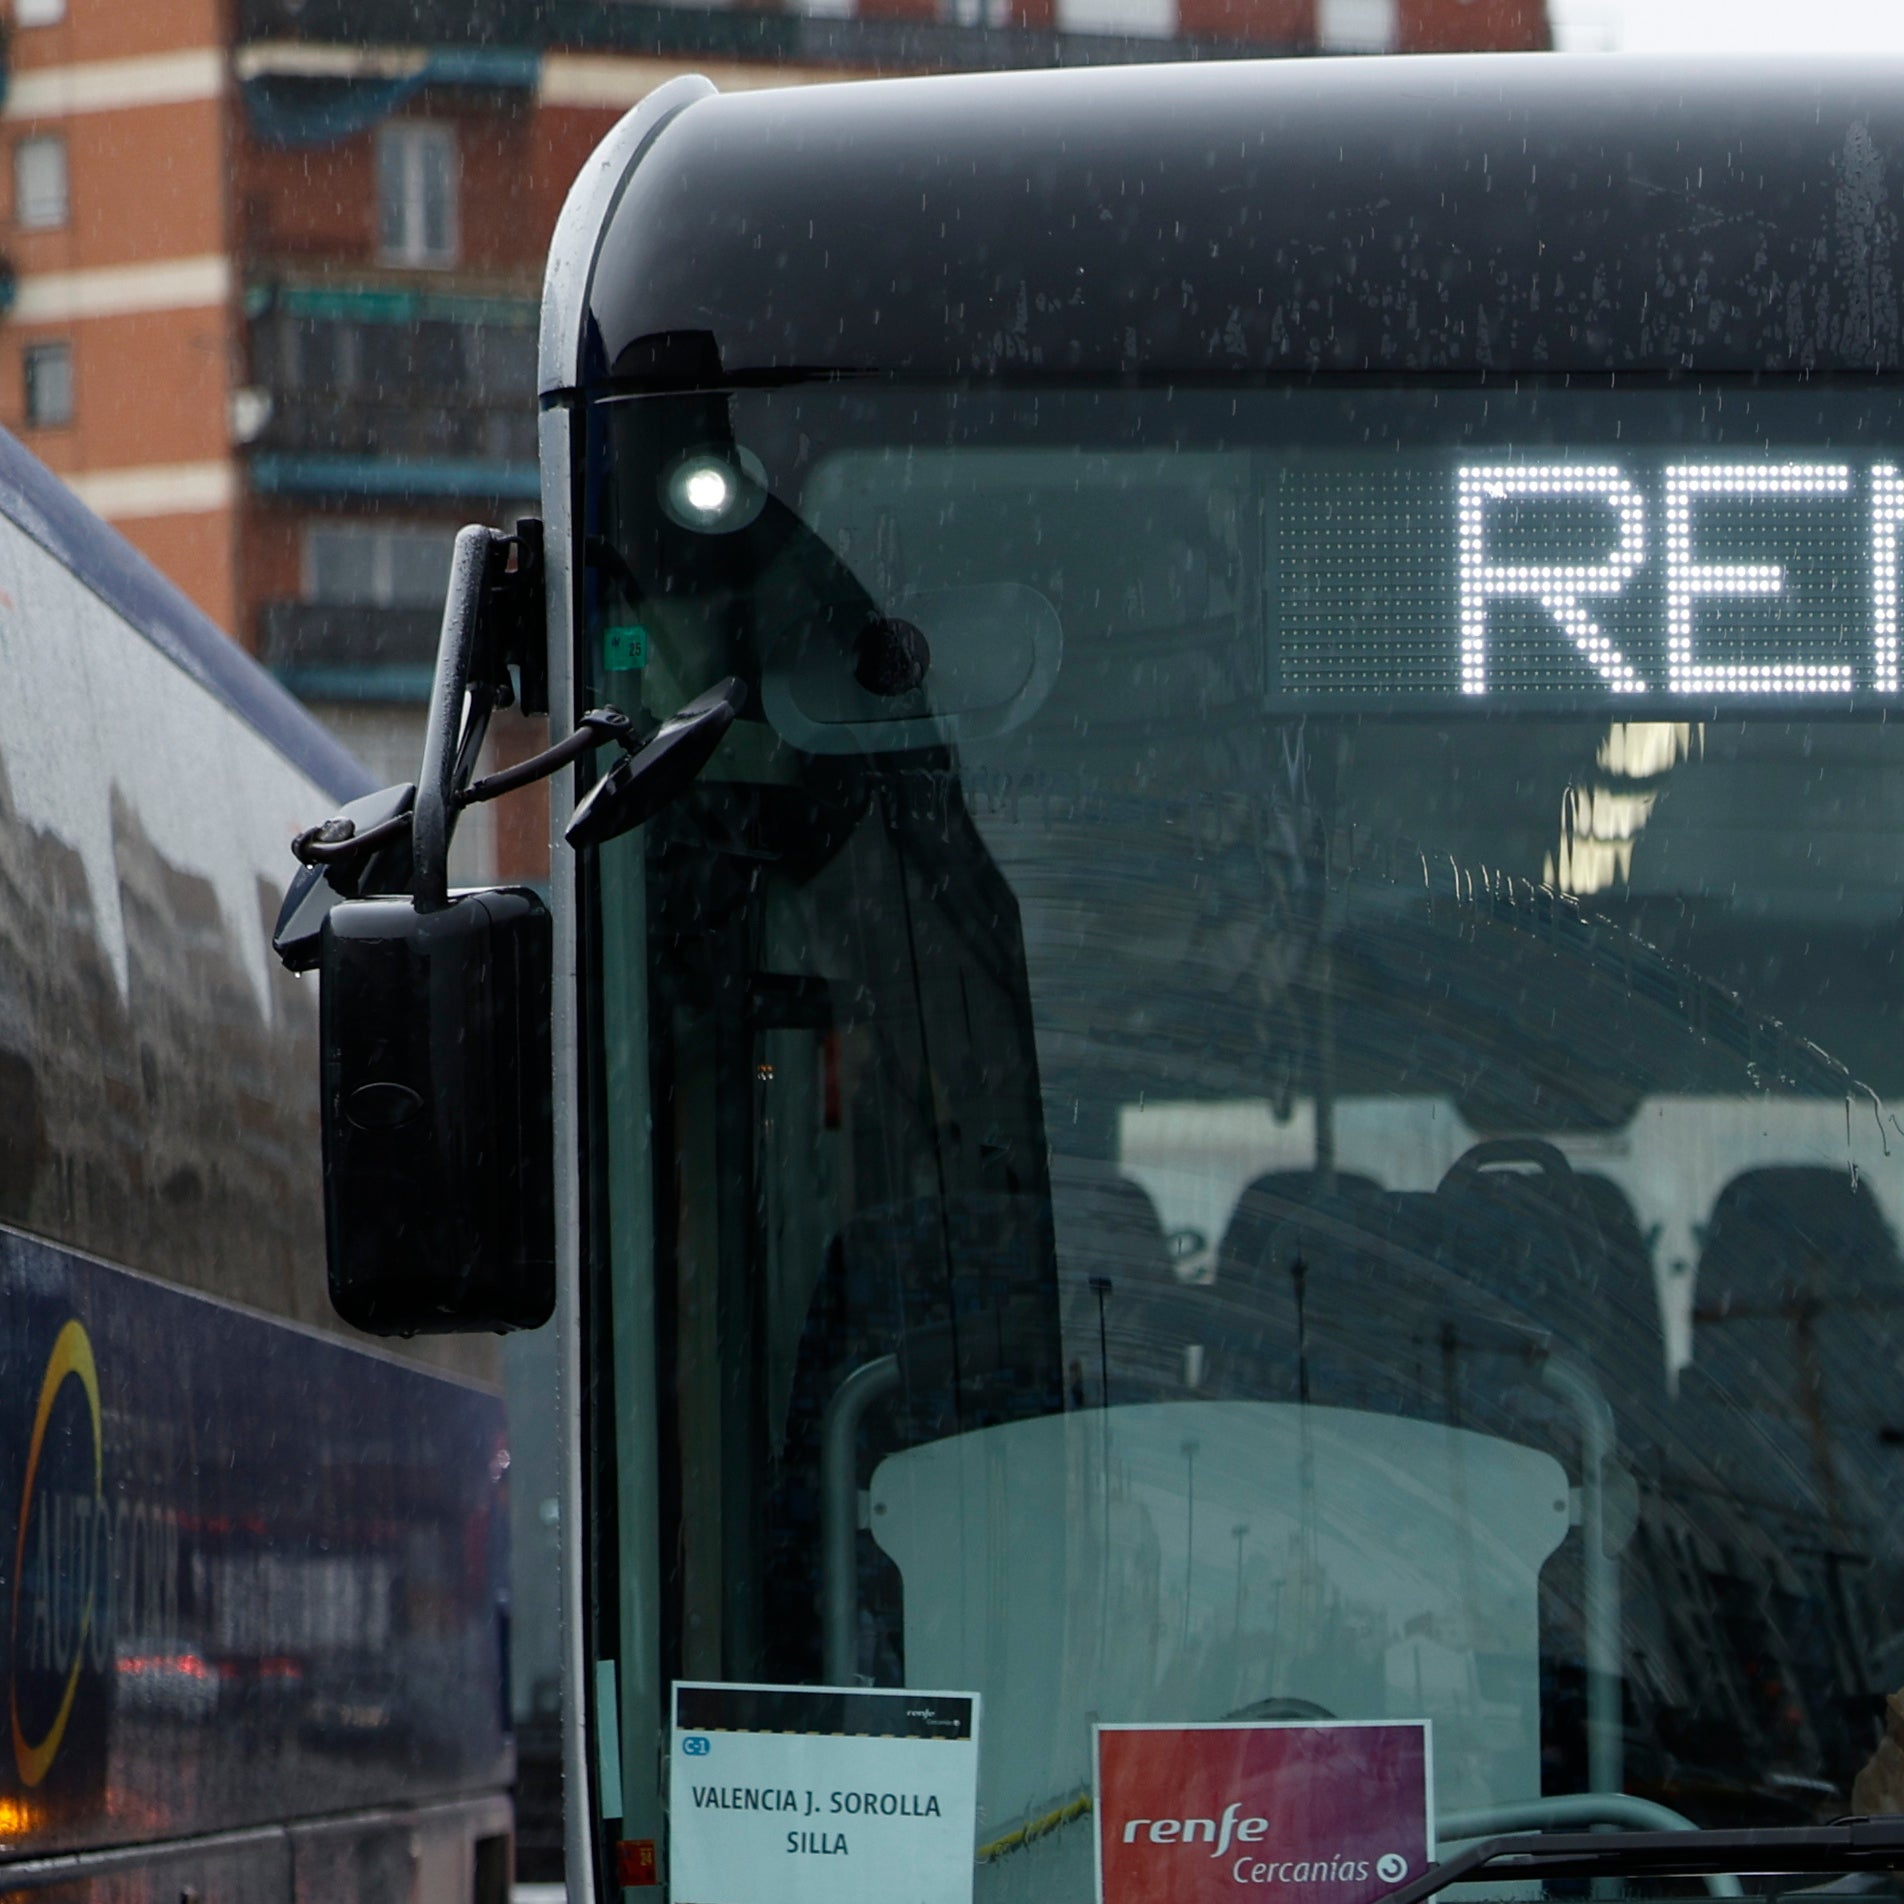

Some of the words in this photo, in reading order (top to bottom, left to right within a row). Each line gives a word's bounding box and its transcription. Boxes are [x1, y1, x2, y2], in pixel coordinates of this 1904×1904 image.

[692, 1786, 798, 1812] VALENCIA
[804, 1791, 821, 1816] J.
[830, 1791, 941, 1817] SOROLLA
[786, 1831, 848, 1855] SILLA
[1122, 1802, 1269, 1858] renfe
[1233, 1853, 1369, 1884] Cercanías
